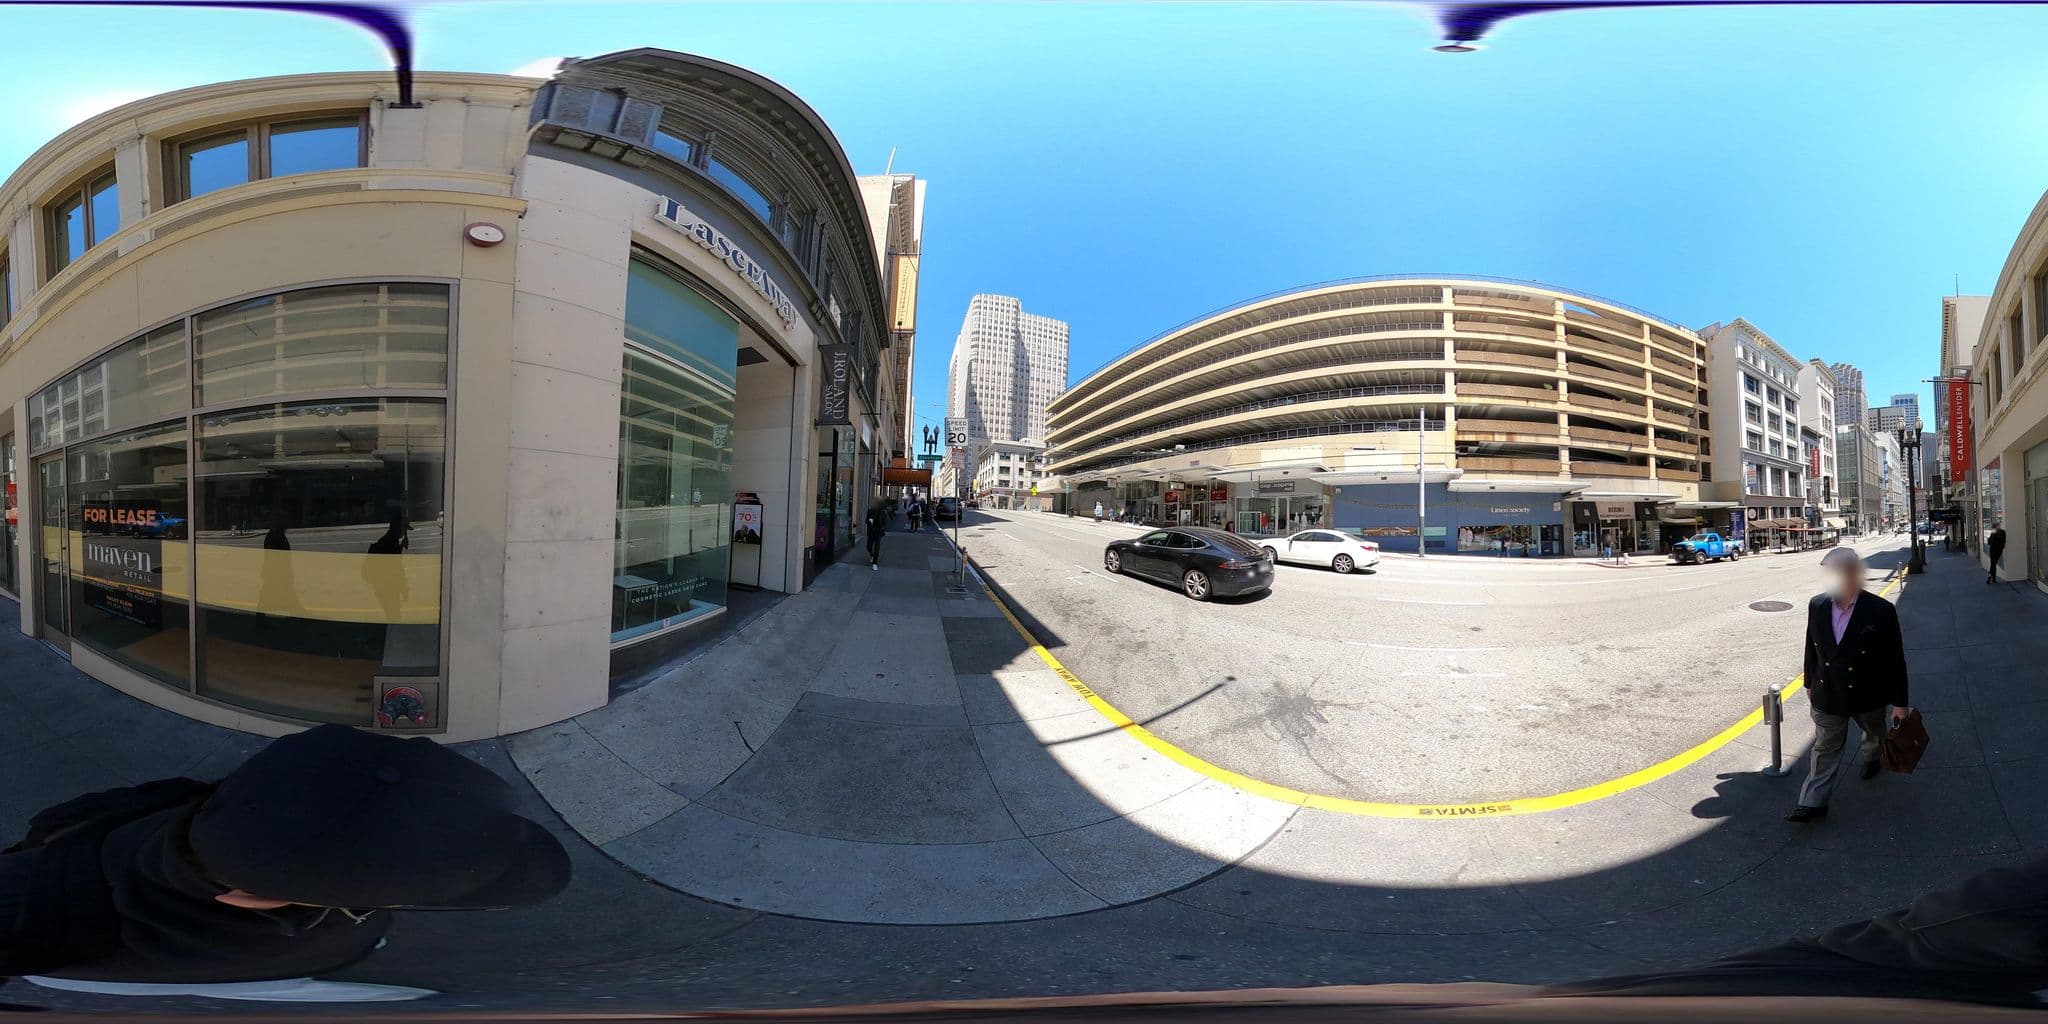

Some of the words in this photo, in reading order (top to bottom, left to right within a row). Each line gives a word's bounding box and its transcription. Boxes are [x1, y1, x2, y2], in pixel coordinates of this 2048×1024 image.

[824, 385, 834, 415] SALON
[948, 432, 966, 443] 20
[84, 508, 107, 523] FOR
[109, 508, 157, 527] LEASE
[88, 543, 152, 573] maven
[123, 570, 152, 583] RETAIL
[1072, 685, 1095, 699] TOW
[1435, 805, 1497, 816] SFMTA
